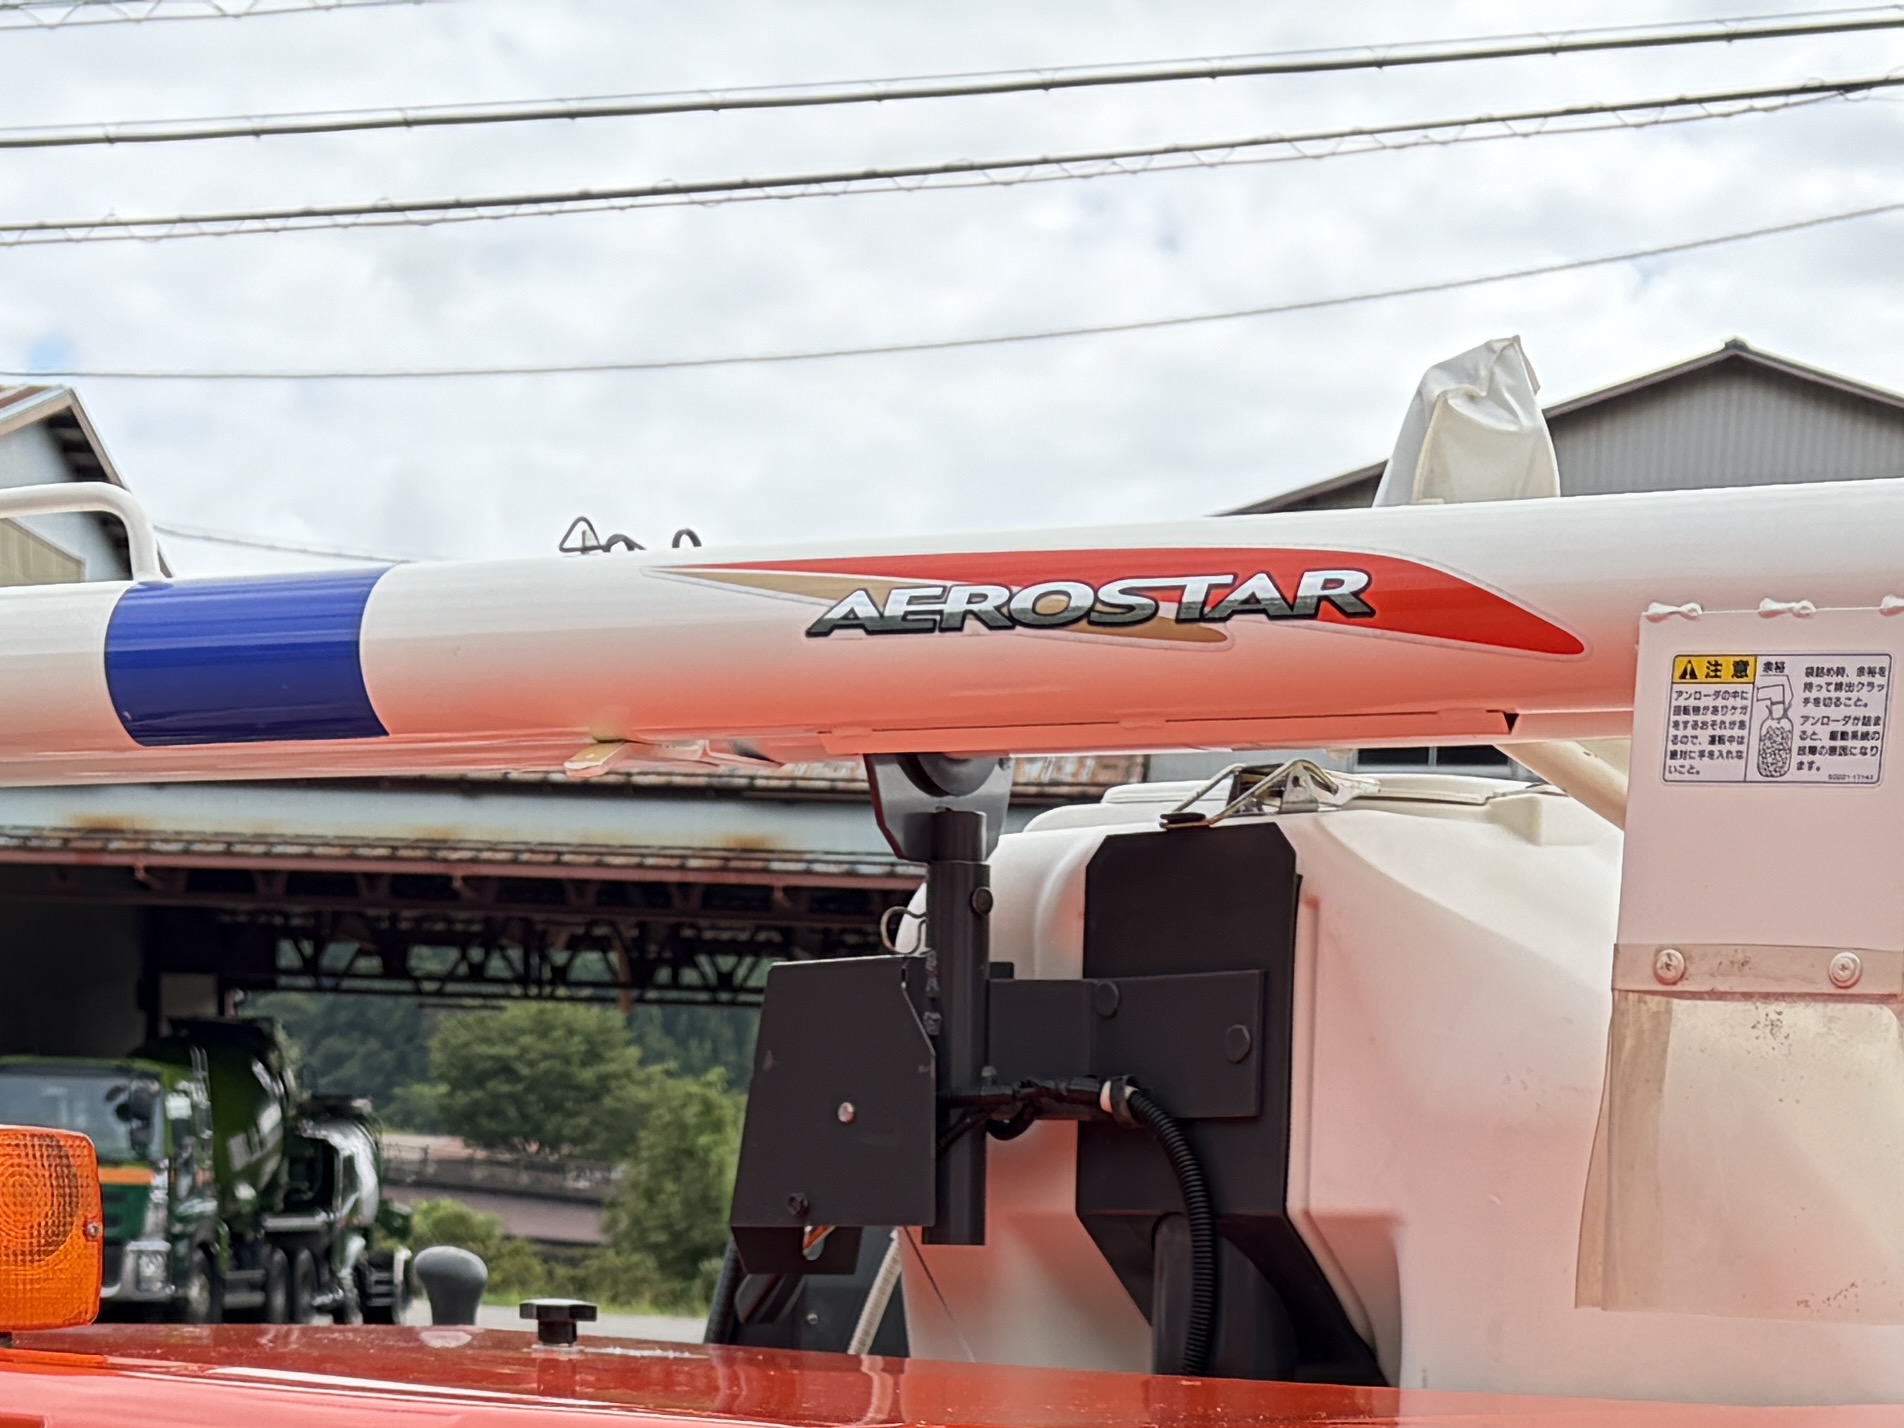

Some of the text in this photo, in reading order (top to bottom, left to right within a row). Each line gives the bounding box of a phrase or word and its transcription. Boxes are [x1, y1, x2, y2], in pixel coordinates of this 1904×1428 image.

[805, 568, 1377, 637] AEROSTAR
[1705, 660, 1749, 678] 注意
[1674, 690, 1749, 700] アンローダの中に
[1668, 764, 1700, 774] いこと。
[1796, 761, 1820, 771] ます。
